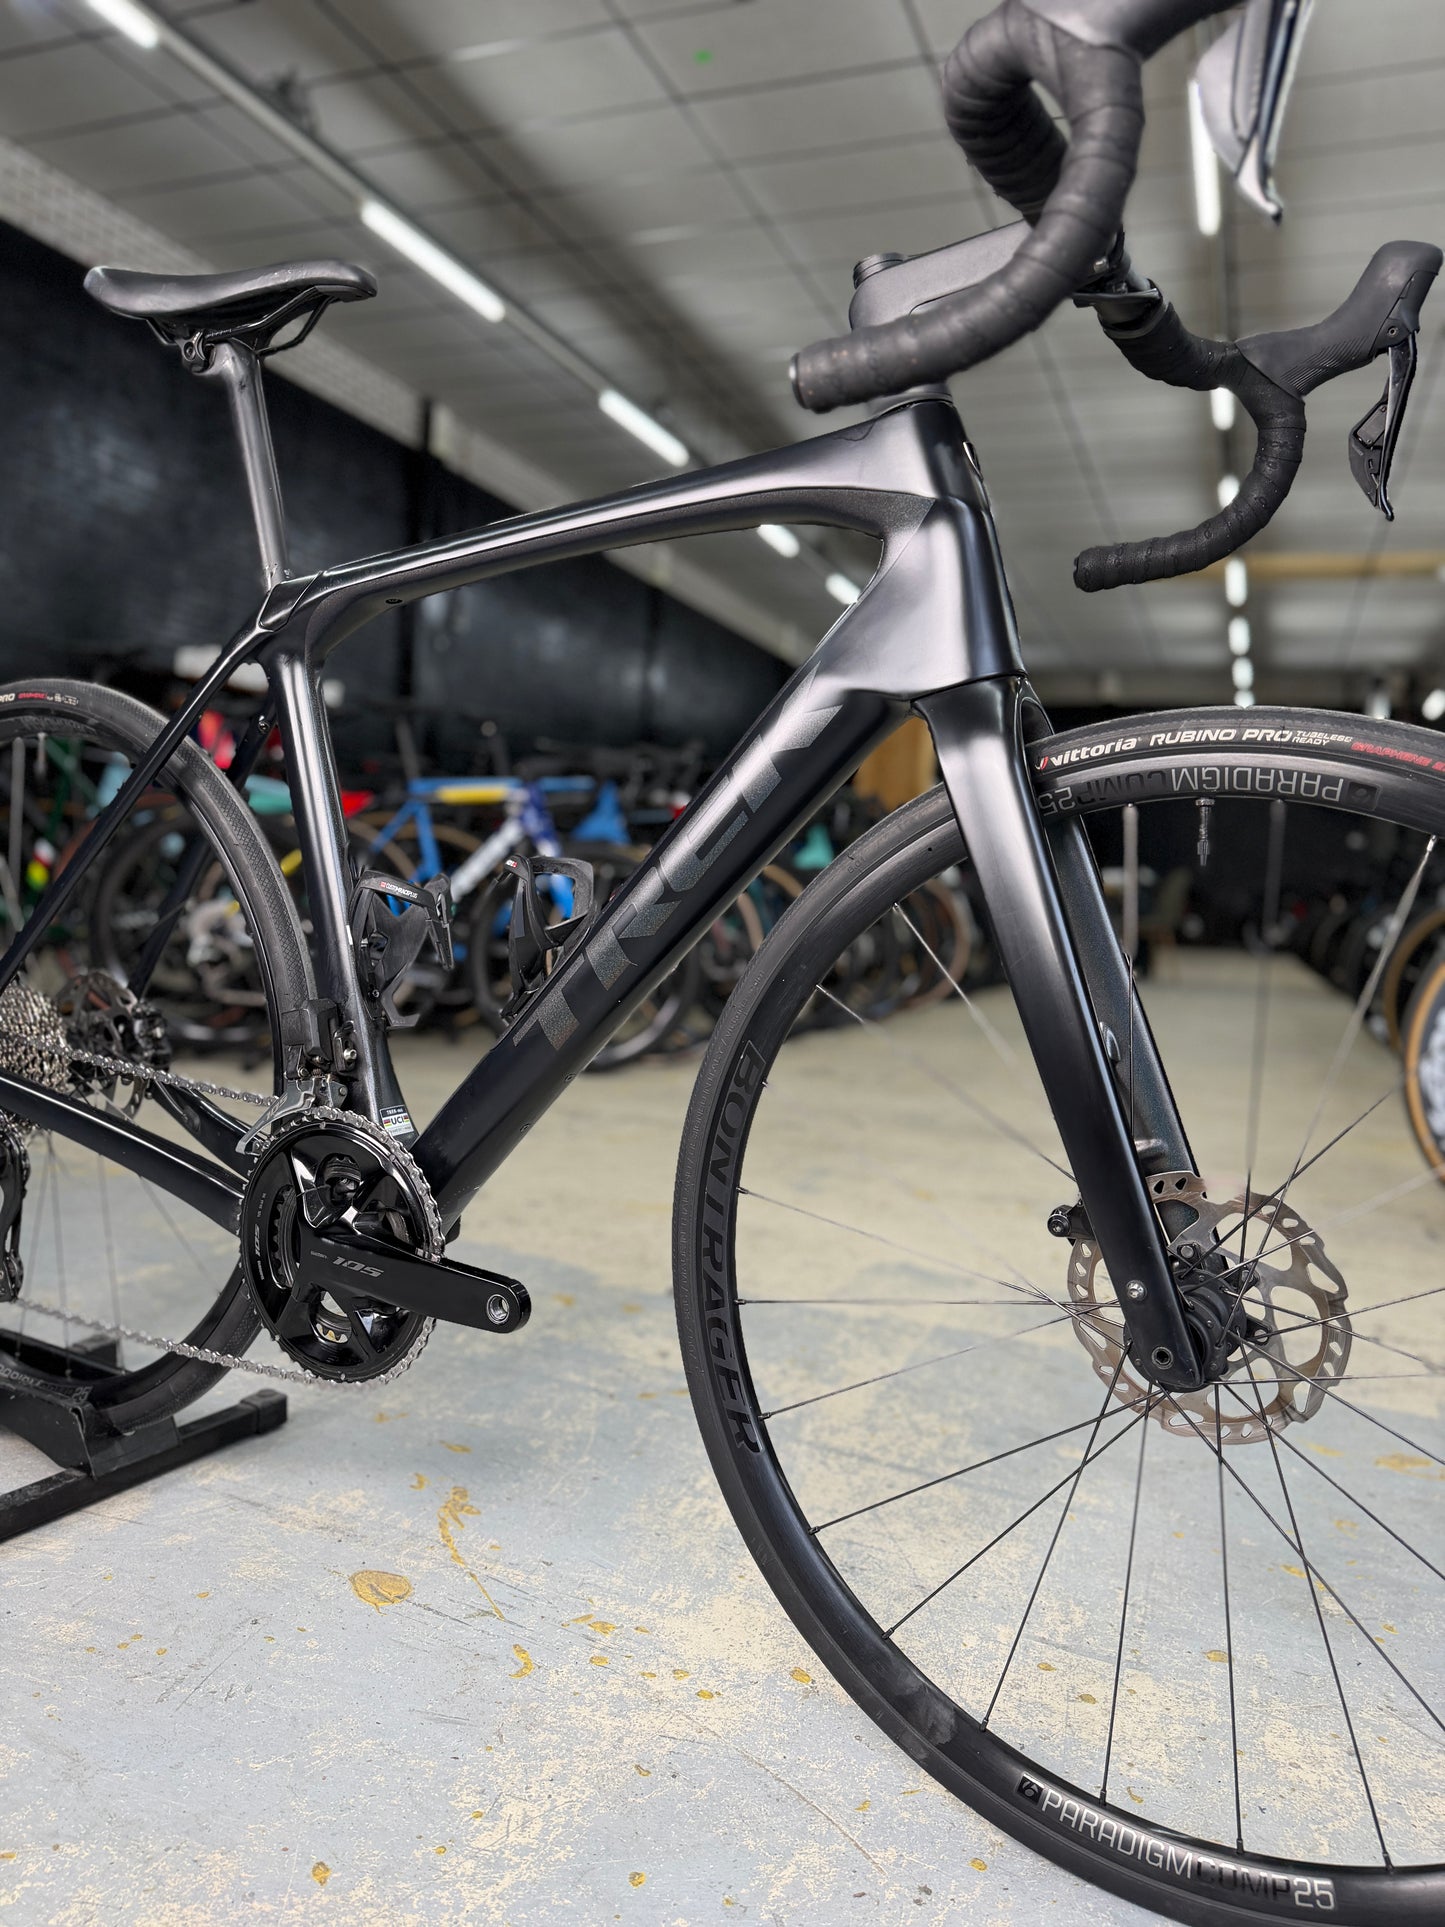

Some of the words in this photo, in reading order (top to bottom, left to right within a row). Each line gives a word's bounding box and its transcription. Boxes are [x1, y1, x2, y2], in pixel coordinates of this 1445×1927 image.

[1149, 729, 1237, 747] RUBINO
[1242, 729, 1294, 743] PRO
[1291, 736, 1330, 746] READY
[1296, 730, 1354, 743] TUBELESS
[1171, 767, 1345, 802] PARADIGM
[1038, 786, 1076, 816] 25
[513, 660, 843, 1050] TREK
[390, 1115, 405, 1125] UCI
[702, 1040, 766, 1454] BONTRAGER
[332, 1256, 385, 1278] 105
[1041, 1788, 1194, 1879] PARADIGM
[1196, 1856, 1291, 1900] COMP
[1293, 1877, 1336, 1911] 25
